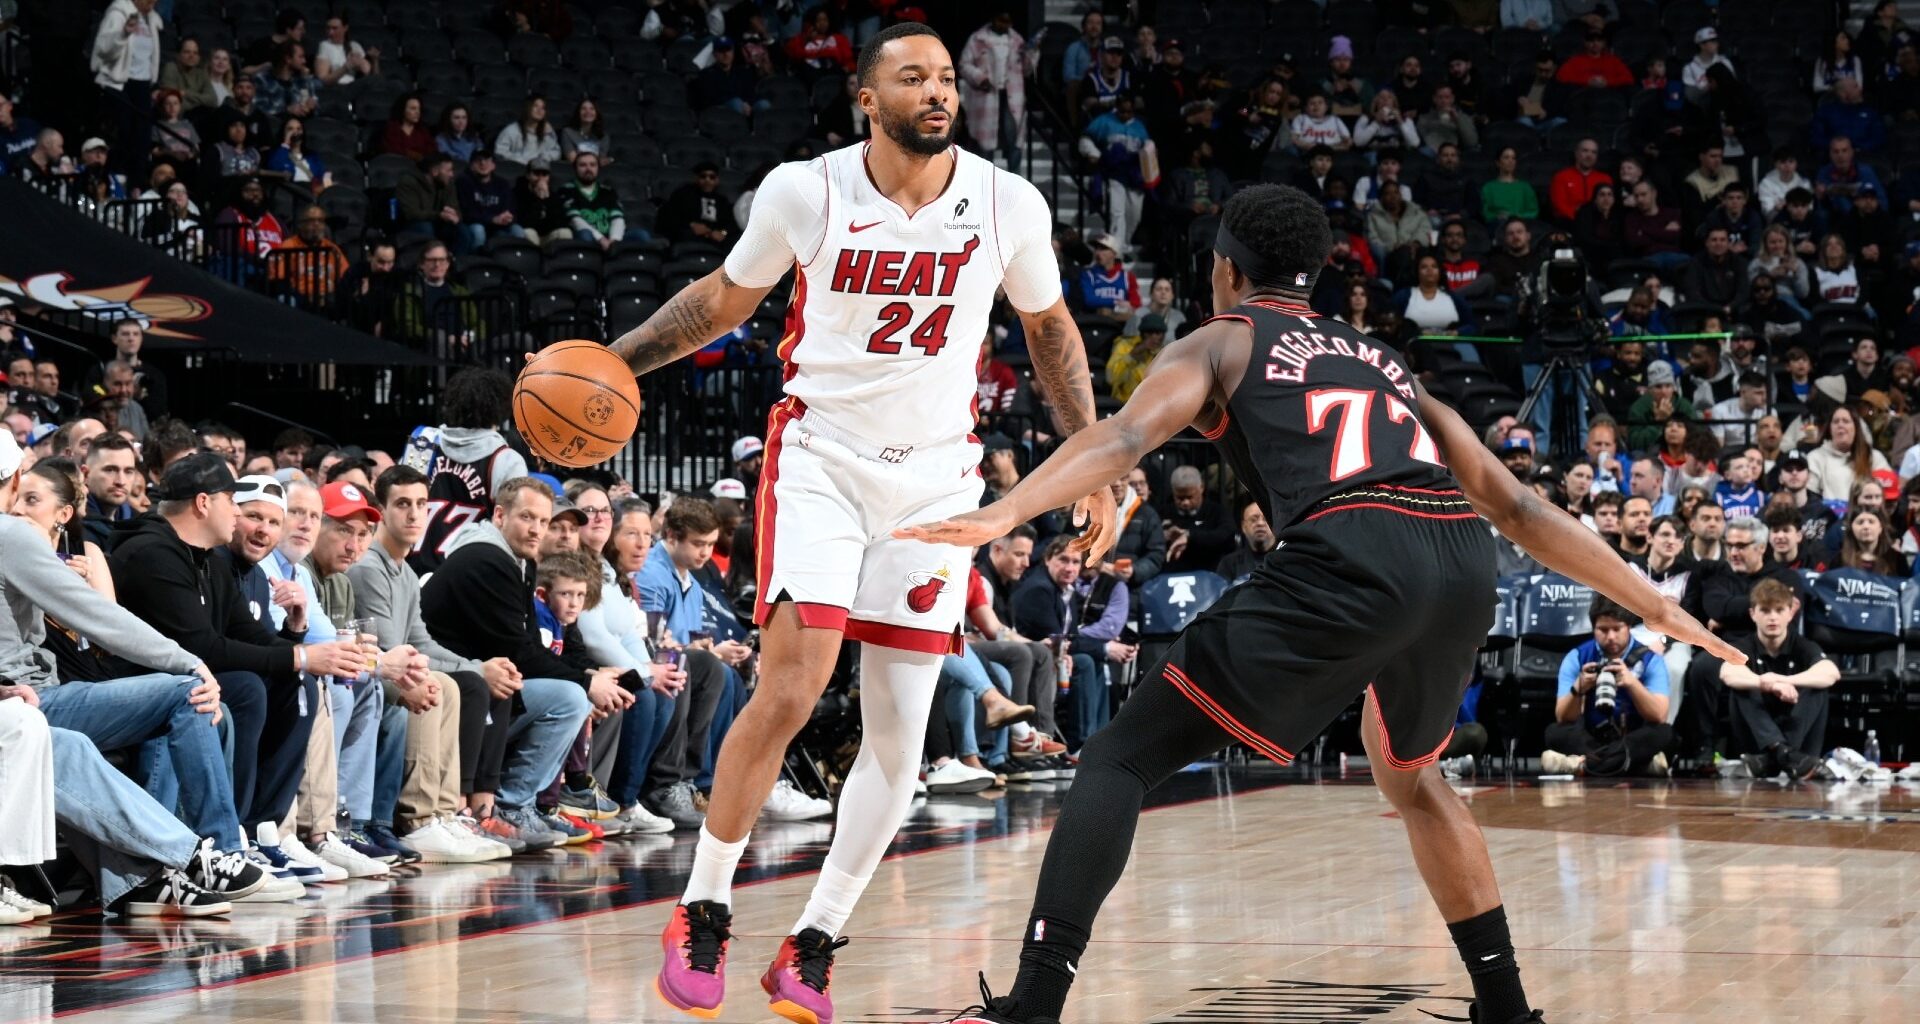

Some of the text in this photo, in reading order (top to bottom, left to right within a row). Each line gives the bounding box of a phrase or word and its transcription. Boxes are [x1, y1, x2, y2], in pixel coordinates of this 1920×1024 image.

[943, 222, 981, 231] Robinhood
[830, 233, 981, 297] HEAT
[866, 301, 955, 357] 24
[1265, 330, 1417, 401] EDGECOMBE
[1305, 388, 1448, 482] 77
[1540, 584, 1575, 602] NJM
[1838, 577, 1874, 597] NJM
